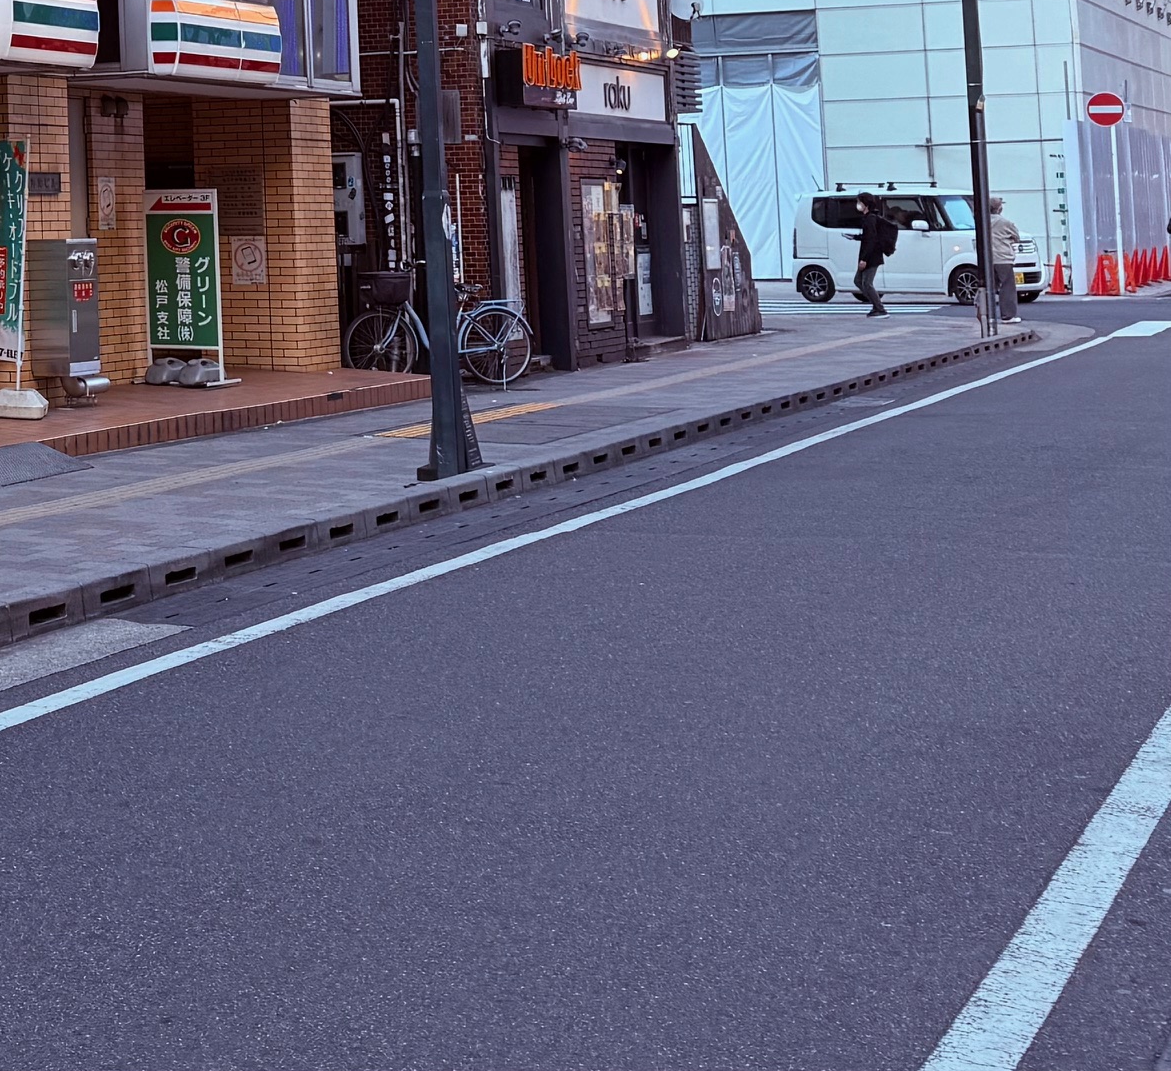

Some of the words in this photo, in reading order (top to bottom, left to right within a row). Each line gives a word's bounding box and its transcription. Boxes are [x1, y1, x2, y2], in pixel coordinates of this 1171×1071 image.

[3, 153, 18, 321] ケーキ・オードブル
[155, 279, 171, 340] 松戸支社
[175, 257, 194, 341] 警備保障(株)
[195, 257, 213, 326] グリーン
